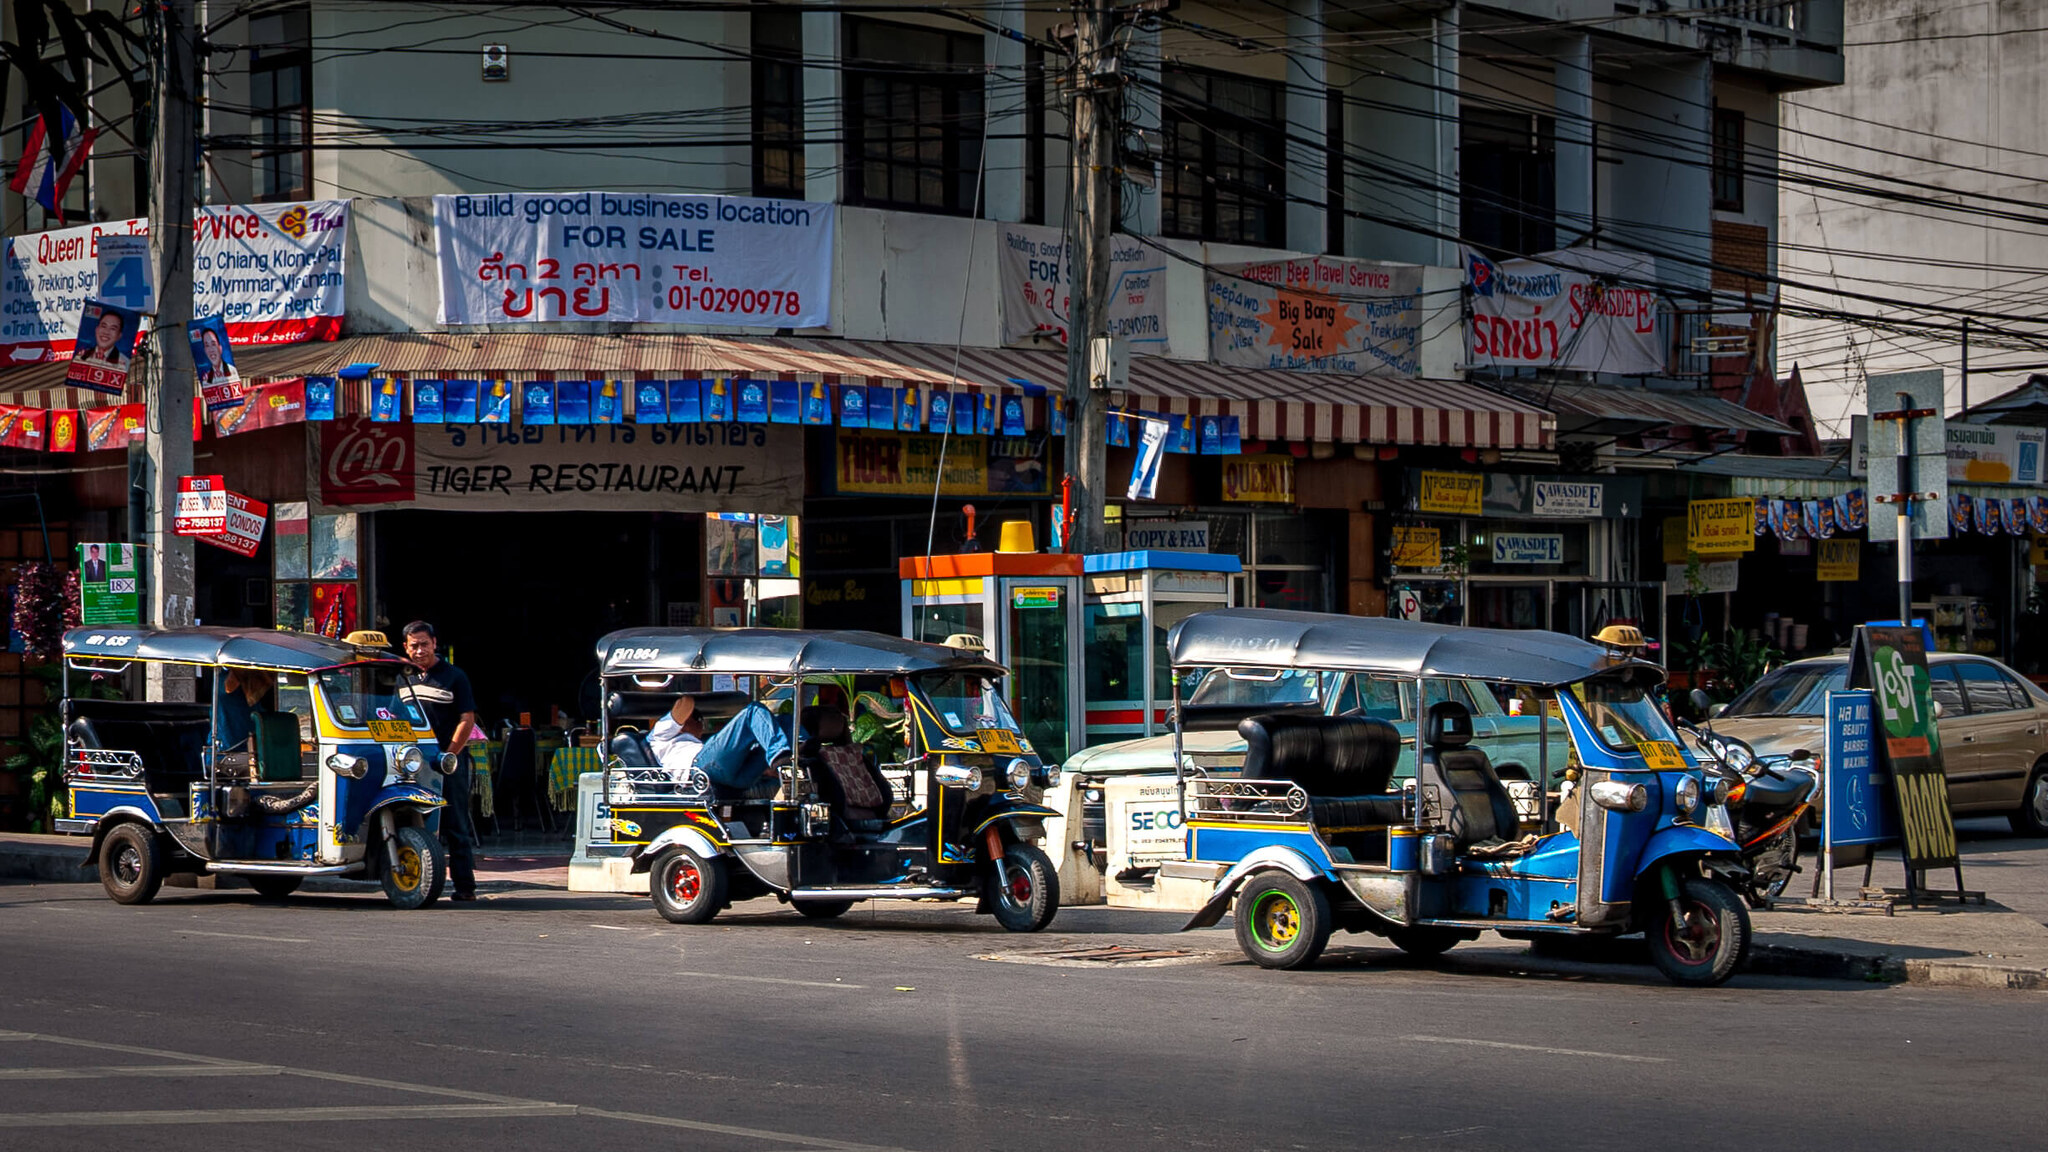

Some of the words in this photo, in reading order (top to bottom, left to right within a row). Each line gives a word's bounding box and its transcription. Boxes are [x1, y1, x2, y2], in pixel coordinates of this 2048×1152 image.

[456, 195, 514, 218] Build
[524, 194, 591, 224] good
[601, 193, 709, 220] business
[716, 197, 810, 226] location
[38, 234, 84, 266] Queen
[564, 226, 626, 248] FOR
[639, 227, 715, 253] SALE
[217, 251, 268, 273] Chiang
[478, 251, 527, 281] ตึก
[538, 258, 561, 280] 2
[573, 263, 641, 286] คูหา
[673, 265, 714, 283] Tel.
[1029, 260, 1061, 284] FOR
[1287, 260, 1310, 282] Bee
[1313, 259, 1344, 284] Travel
[1349, 265, 1390, 289] Service
[101, 257, 151, 308] 4
[259, 298, 281, 315] For
[502, 287, 610, 317] ขาย
[668, 285, 801, 316] 01-0290978
[1279, 299, 1299, 325] Big
[1305, 299, 1335, 327] Bang
[12, 320, 35, 336] Train
[1292, 327, 1323, 350] Sale
[191, 479, 212, 491] RENT
[427, 465, 512, 495] TIGER
[529, 462, 745, 495] RESTAURANT
[1227, 461, 1277, 499] QUEEN
[226, 493, 249, 510] ENT
[1536, 483, 1600, 509] SAWASDEE
[175, 517, 225, 528] 09-7568137
[1707, 503, 1726, 519] CAR
[230, 512, 262, 536] CONDOS
[1496, 537, 1560, 560] SAWASDEE
[363, 633, 385, 643] TAXI
[1874, 650, 1919, 723] LOST
[390, 722, 409, 734] 635
[1842, 723, 1868, 736] BEAUTY
[1896, 773, 1956, 859] BOOKS
